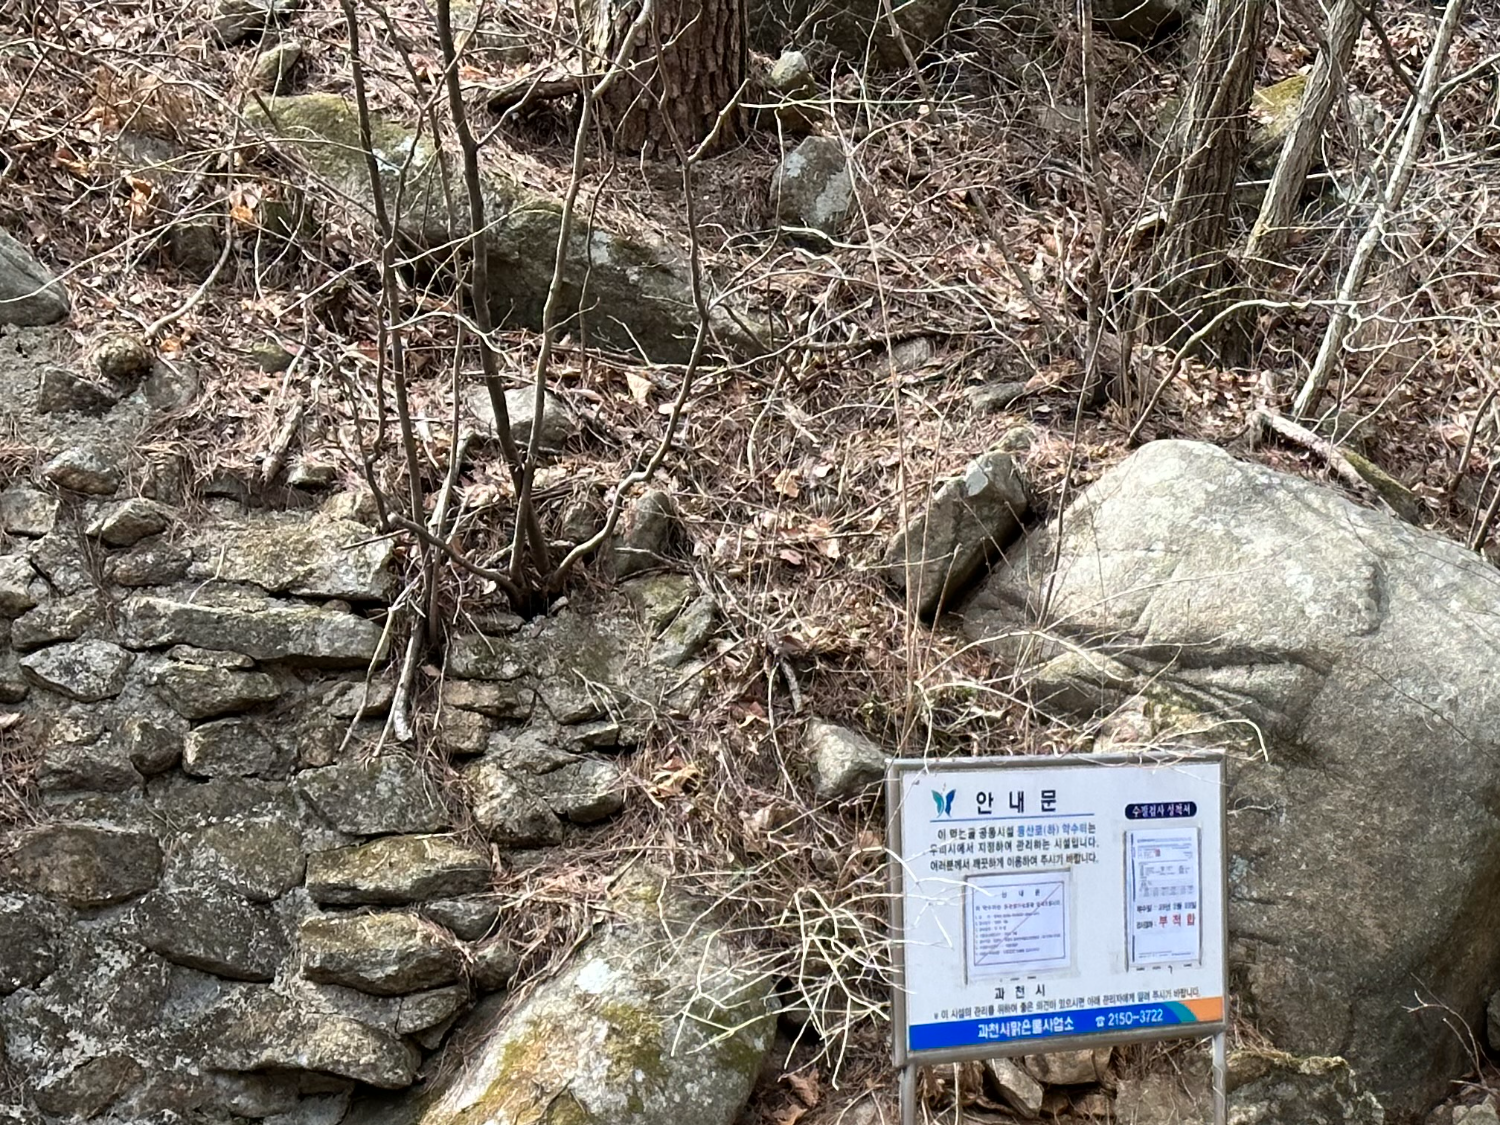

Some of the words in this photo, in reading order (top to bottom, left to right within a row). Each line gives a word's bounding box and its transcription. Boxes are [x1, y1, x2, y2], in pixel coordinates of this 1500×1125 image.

[937, 828, 946, 840] 이
[978, 840, 1012, 853] 지정하여
[1016, 838, 1051, 852] 관리하는
[1054, 835, 1099, 849] 시설입니다.
[930, 858, 970, 872] 여러분께서
[973, 856, 1004, 870] 깨끗하게
[1006, 855, 1038, 868] 이용하여
[1040, 853, 1064, 866] 주시기
[1065, 851, 1099, 865] 바랍니다.
[974, 1004, 995, 1017] 관리를
[1103, 992, 1135, 1006] 관리자에게
[1107, 1008, 1164, 1027] 2150-3722
